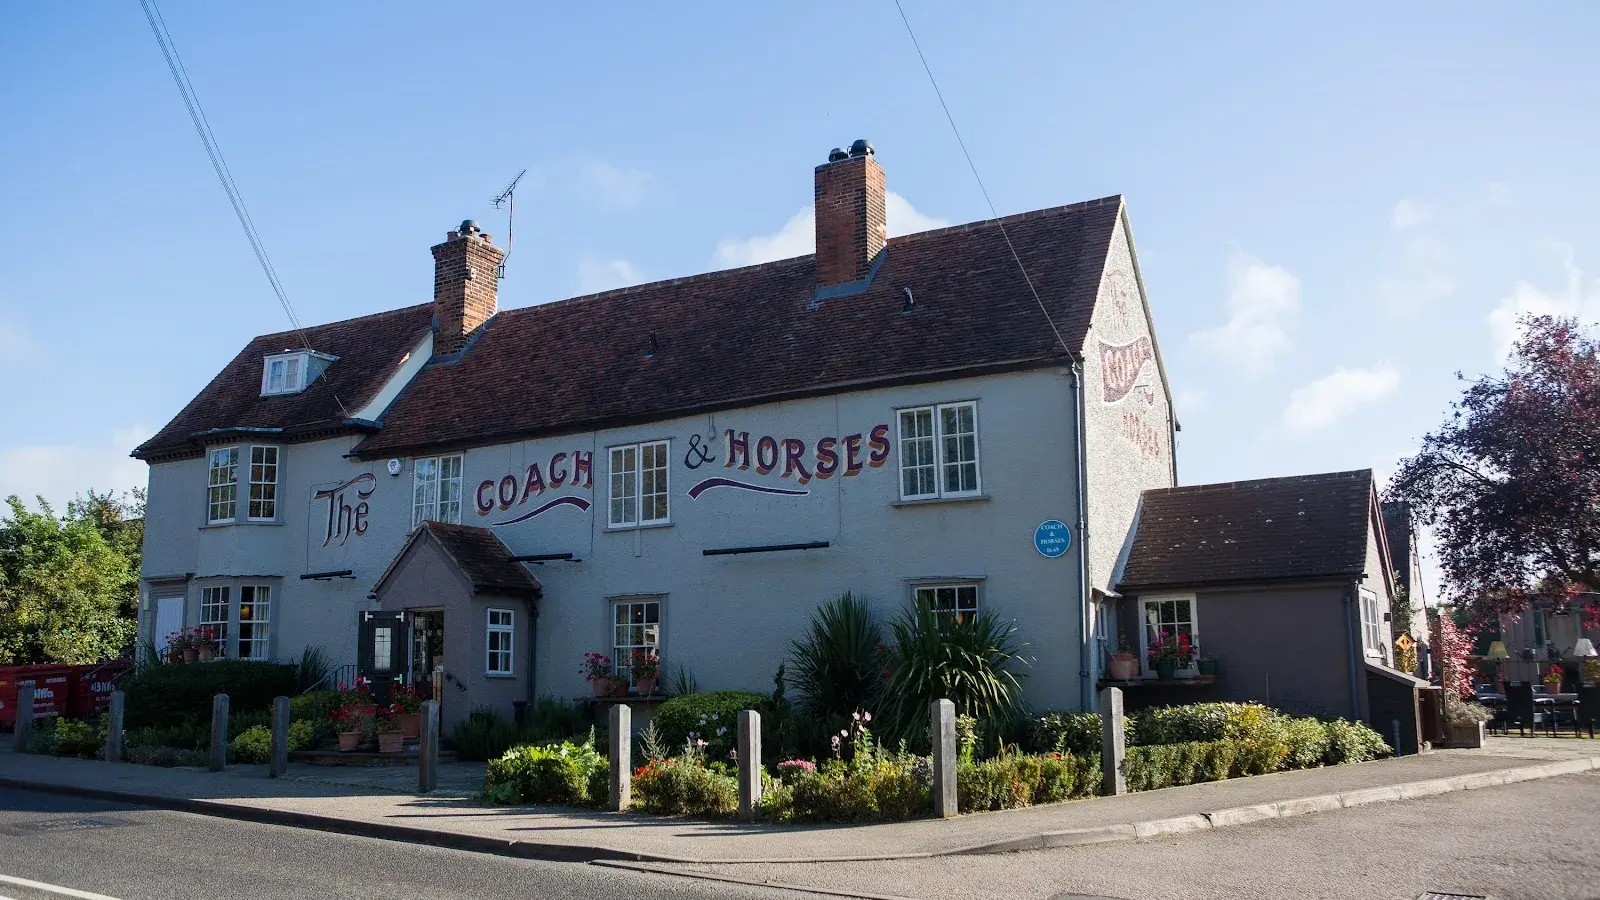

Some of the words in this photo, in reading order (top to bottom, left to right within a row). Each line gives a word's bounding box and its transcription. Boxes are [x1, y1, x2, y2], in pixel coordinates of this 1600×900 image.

[313, 472, 377, 548] The
[474, 450, 594, 517] COACH
[684, 433, 716, 470] &
[723, 424, 891, 485] HORSES
